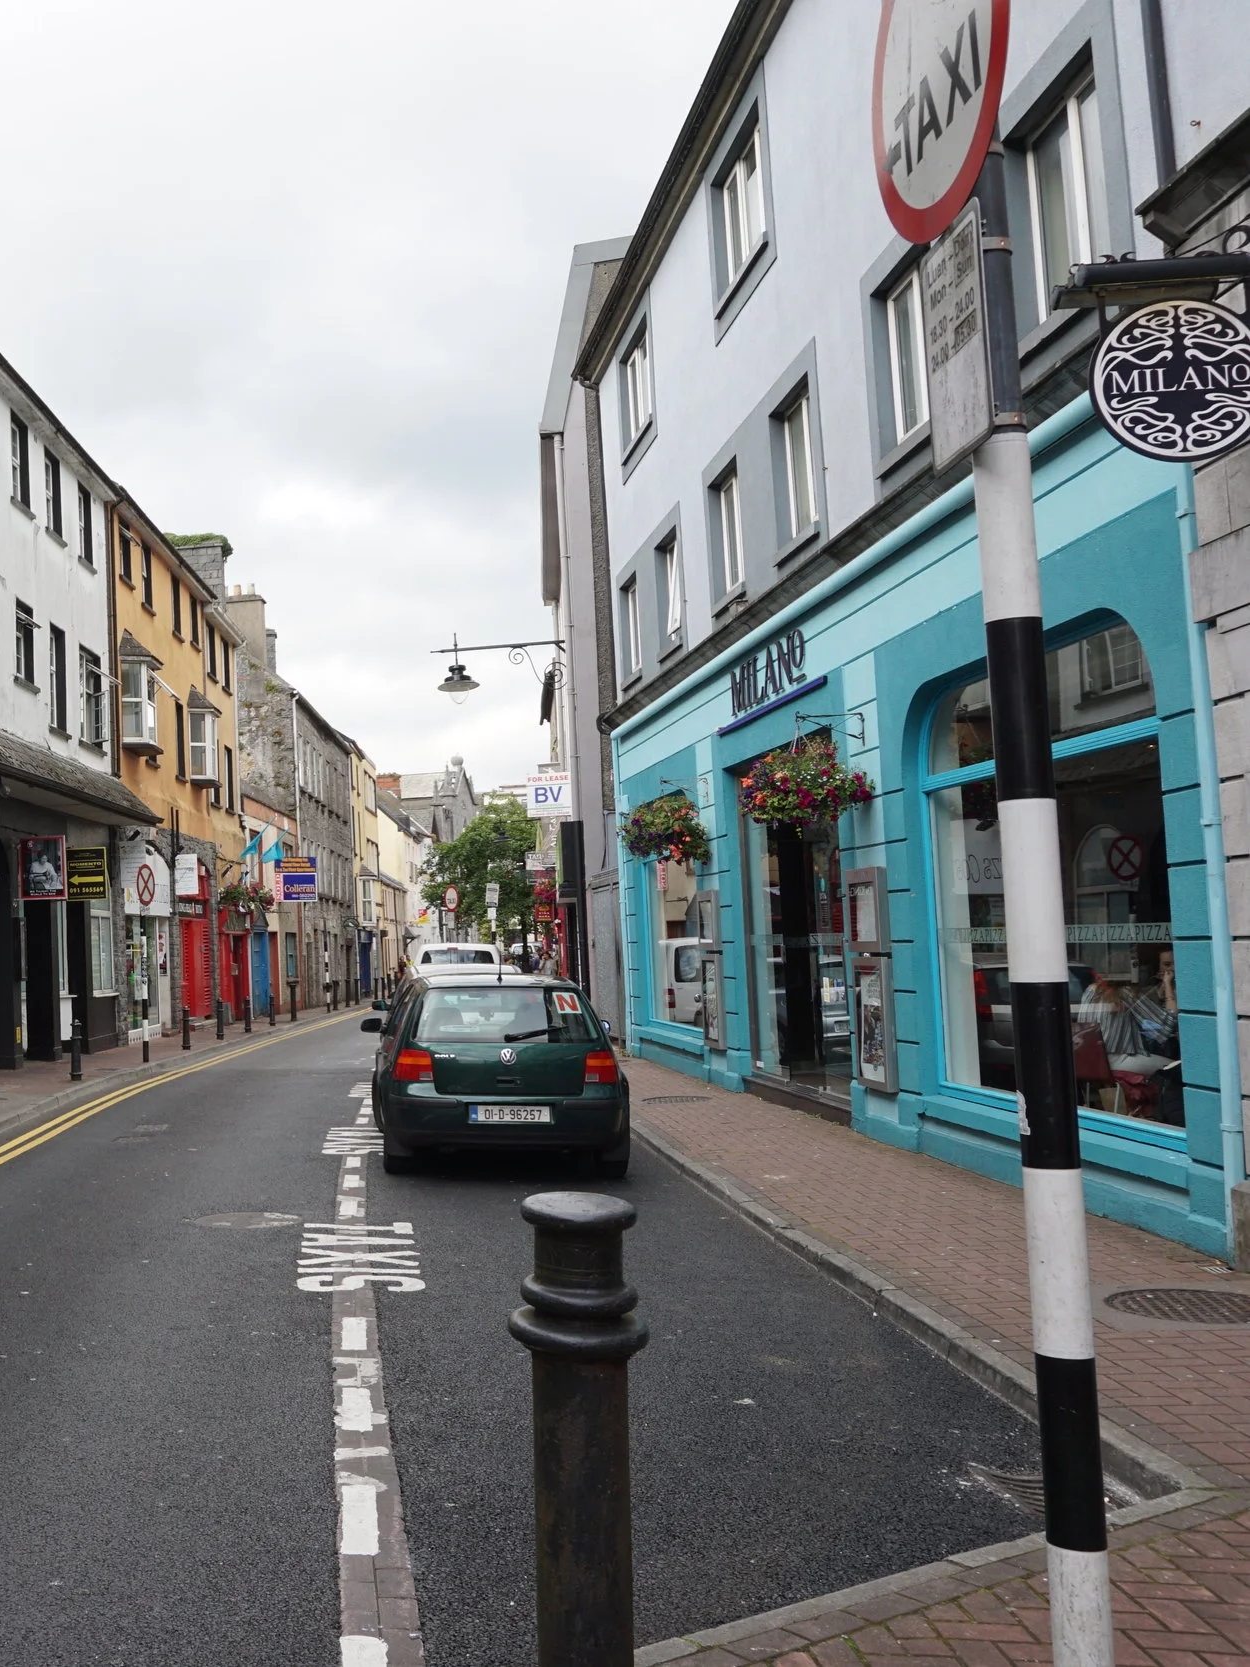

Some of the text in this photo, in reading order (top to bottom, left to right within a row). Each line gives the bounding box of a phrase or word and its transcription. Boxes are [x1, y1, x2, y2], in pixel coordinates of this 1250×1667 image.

[894, 8, 982, 177] TAXI
[930, 285, 947, 311] Mon
[956, 256, 973, 279] Sun
[954, 286, 975, 318] 24.00
[1110, 363, 1250, 395] MILANO
[730, 628, 806, 717] MILANO
[534, 786, 562, 803] BV
[285, 884, 315, 892] Colleran
[555, 994, 579, 1011] N
[484, 1109, 542, 1120] 01-D-96257
[296, 1222, 426, 1292] TAXIS
